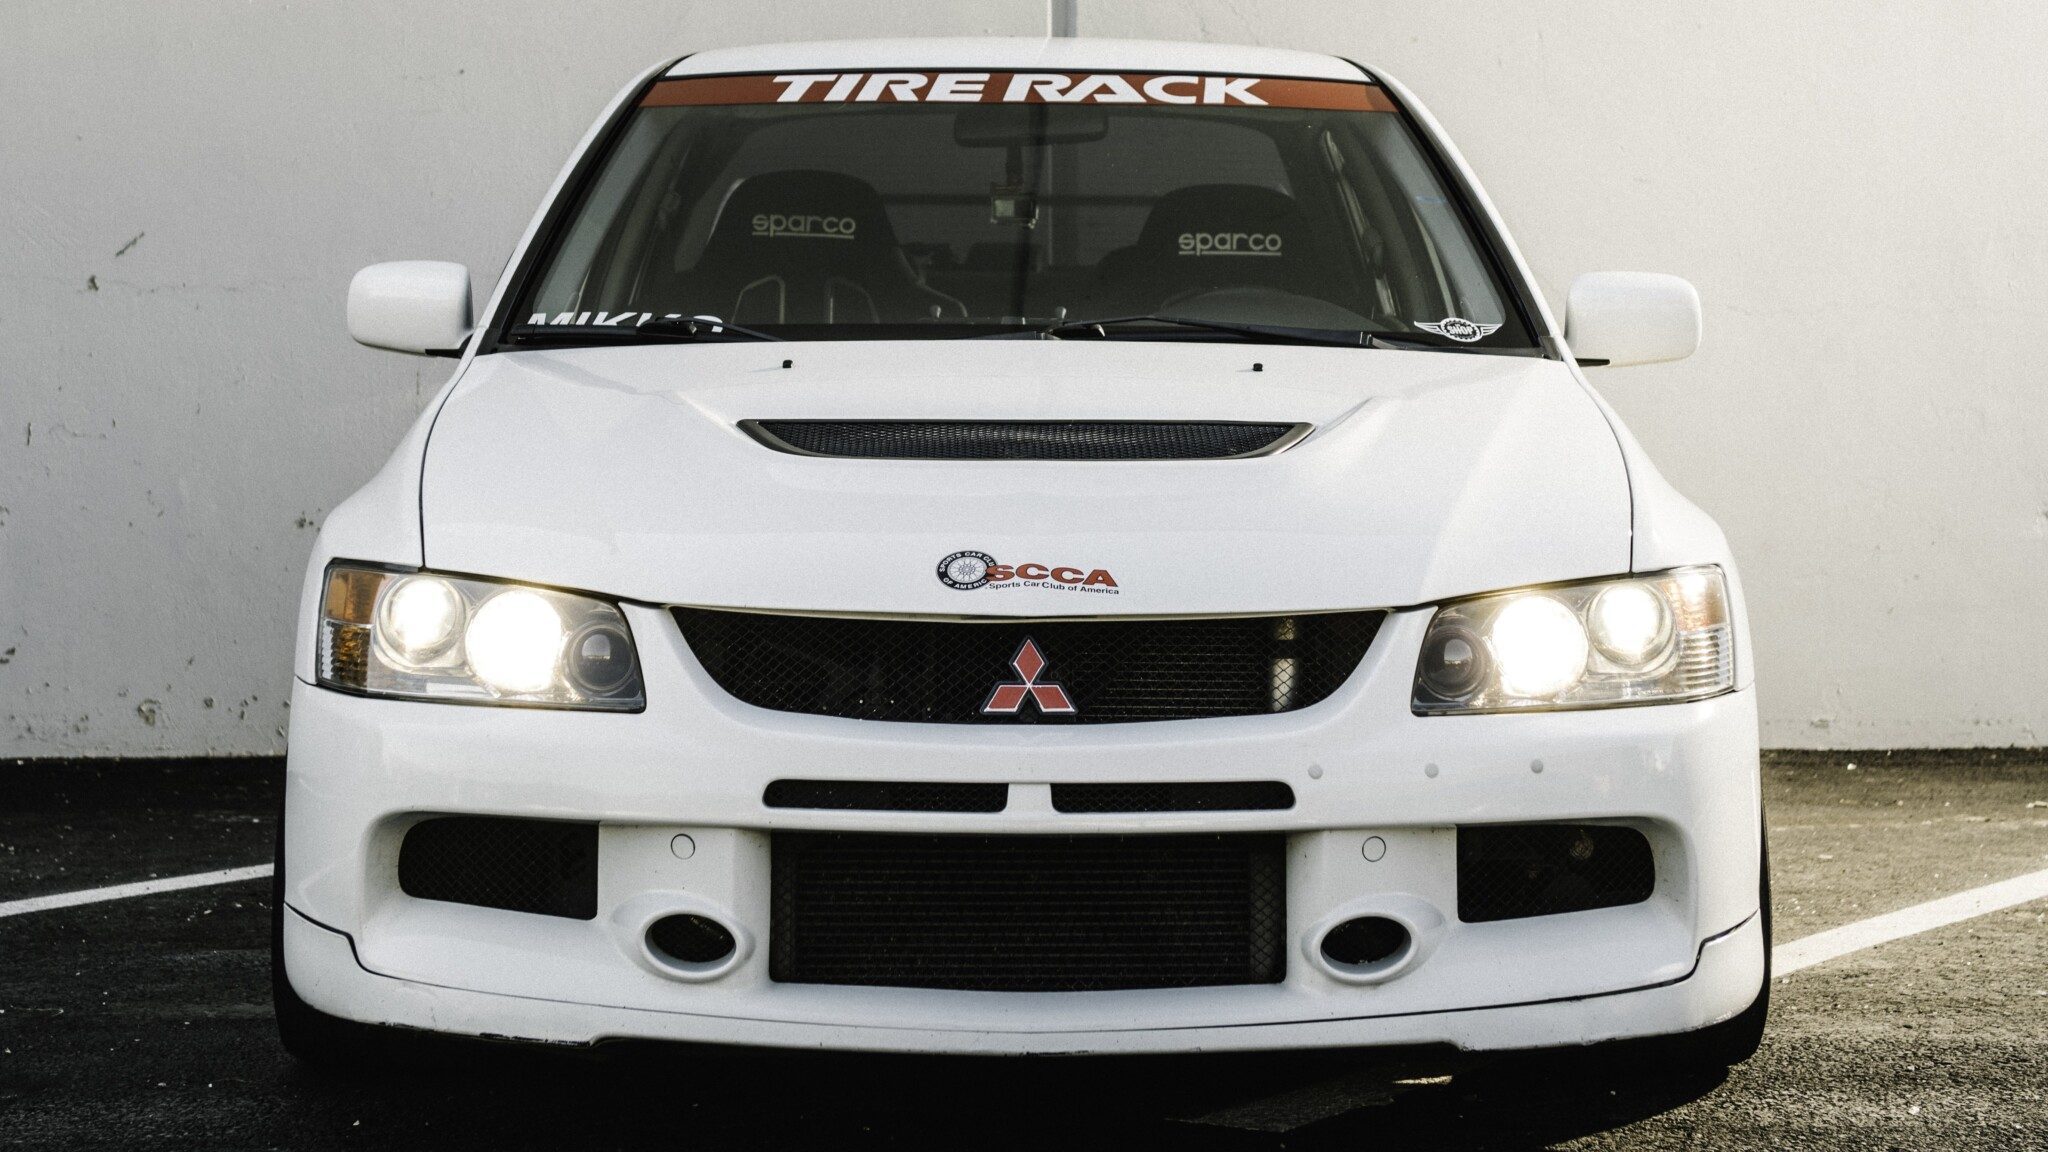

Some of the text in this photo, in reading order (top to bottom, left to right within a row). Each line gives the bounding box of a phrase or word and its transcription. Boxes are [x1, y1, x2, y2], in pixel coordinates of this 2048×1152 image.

[772, 73, 1269, 105] TIRE RACK
[751, 213, 856, 239] sparco
[1178, 232, 1282, 256] sparco
[939, 553, 962, 572] SPORTS
[943, 577, 988, 590] OF AMERIC
[985, 563, 1119, 588] SCCA
[989, 580, 1120, 596] Sports Car Club of America
